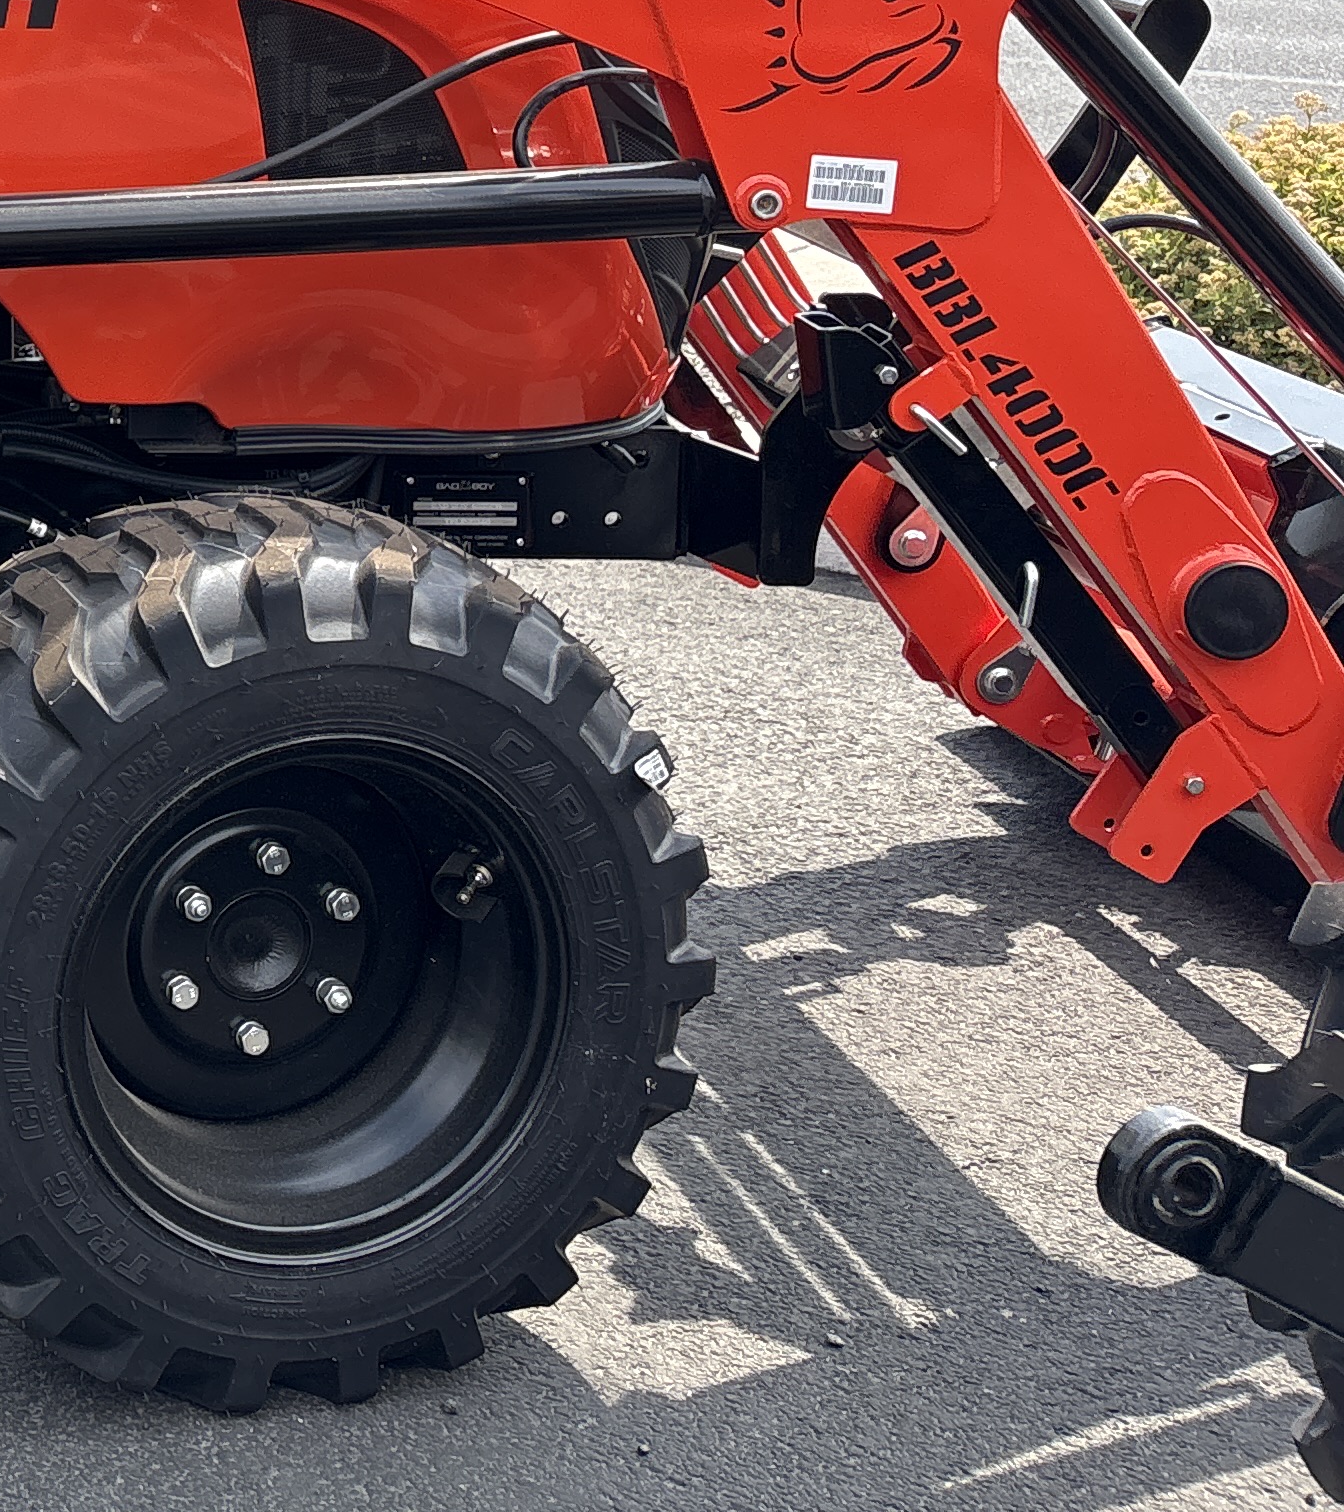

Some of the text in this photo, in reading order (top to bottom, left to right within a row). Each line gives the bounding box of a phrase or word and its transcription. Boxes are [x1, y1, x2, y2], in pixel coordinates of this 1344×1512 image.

[892, 240, 1120, 512] BBL400C
[115, 735, 175, 790] NHS
[482, 719, 638, 1028] CARLSTAR
[34, 1164, 158, 1289] TRAC
